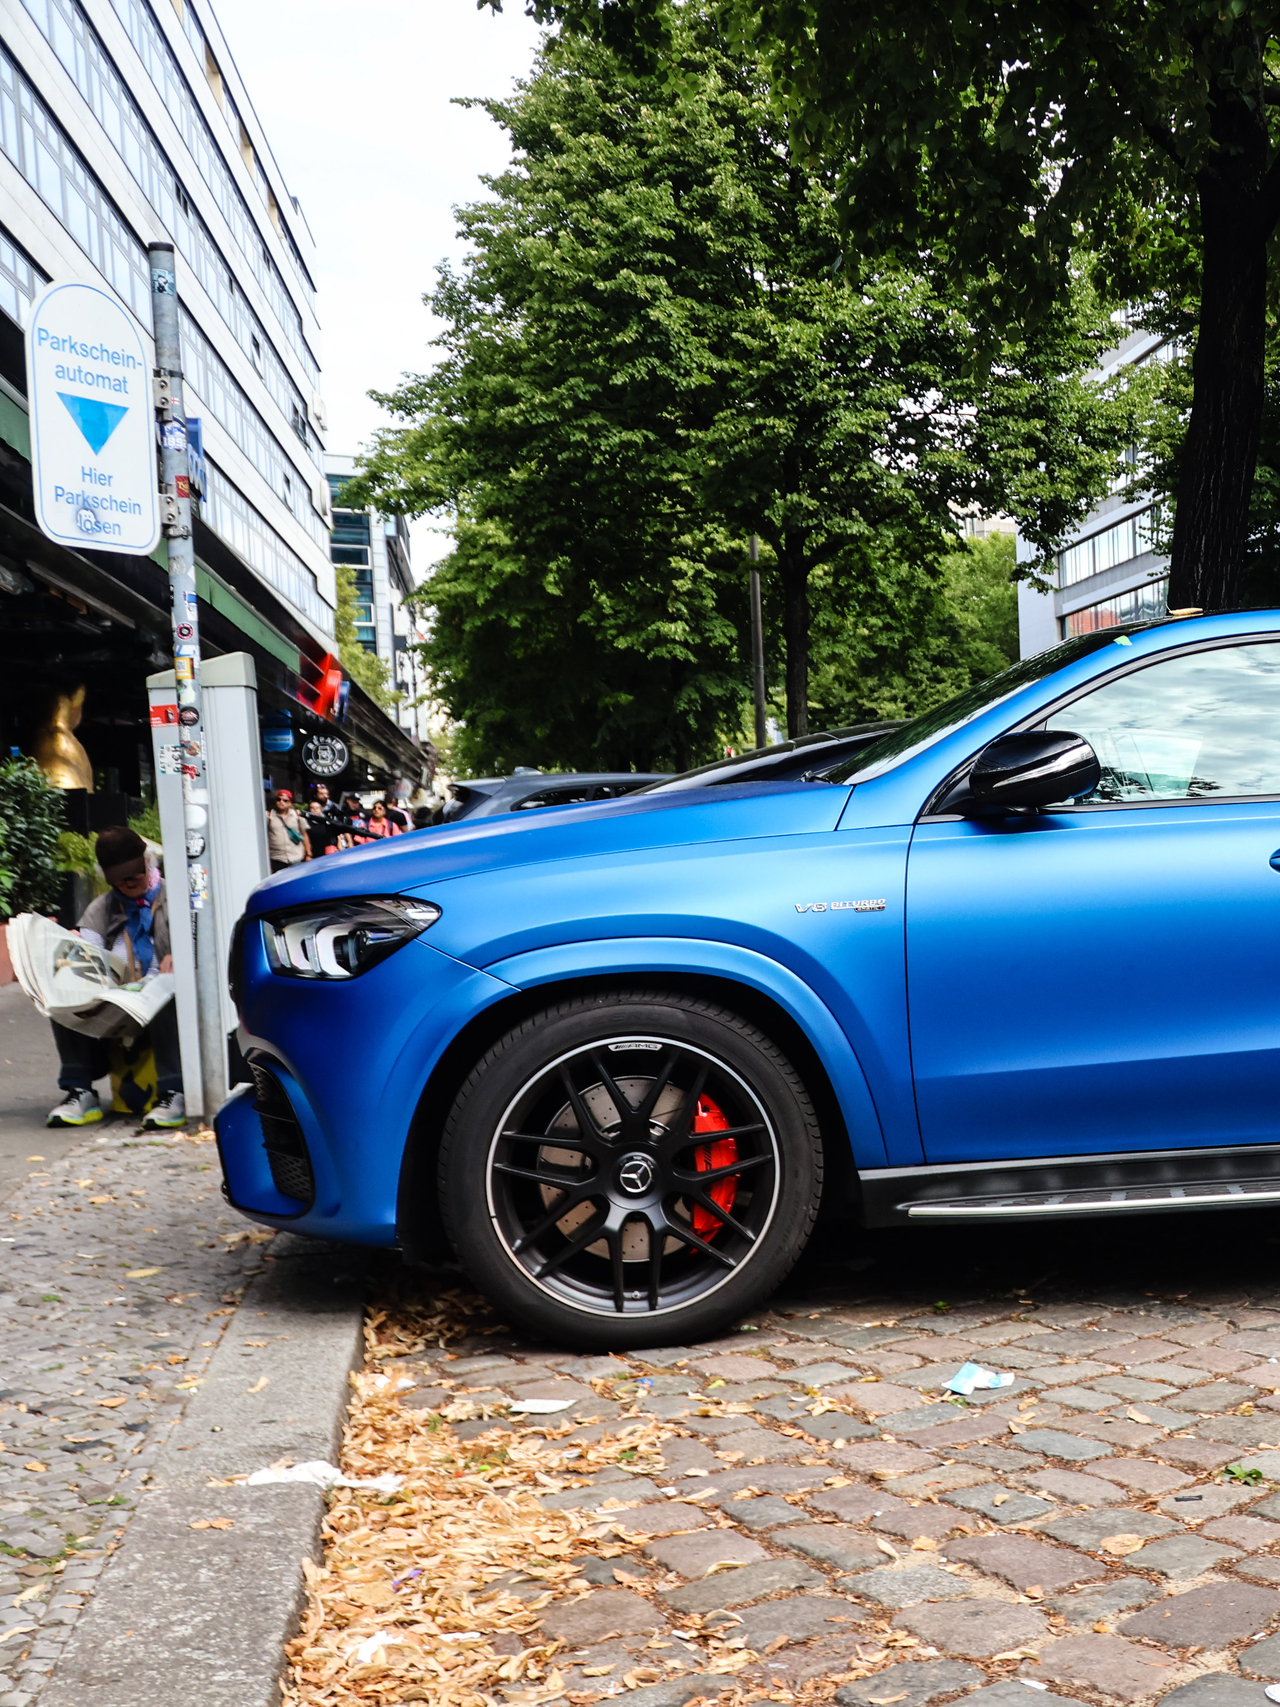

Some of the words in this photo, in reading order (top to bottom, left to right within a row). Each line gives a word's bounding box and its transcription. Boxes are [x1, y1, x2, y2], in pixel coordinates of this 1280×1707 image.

[37, 327, 143, 370] Parkschein-
[55, 364, 129, 394] automat
[81, 466, 113, 486] Hier
[54, 485, 142, 515] Parkschein
[79, 513, 122, 535] lösen
[306, 758, 344, 774] SERVICE
[795, 902, 827, 912] V8
[831, 898, 886, 907] BITURBO
